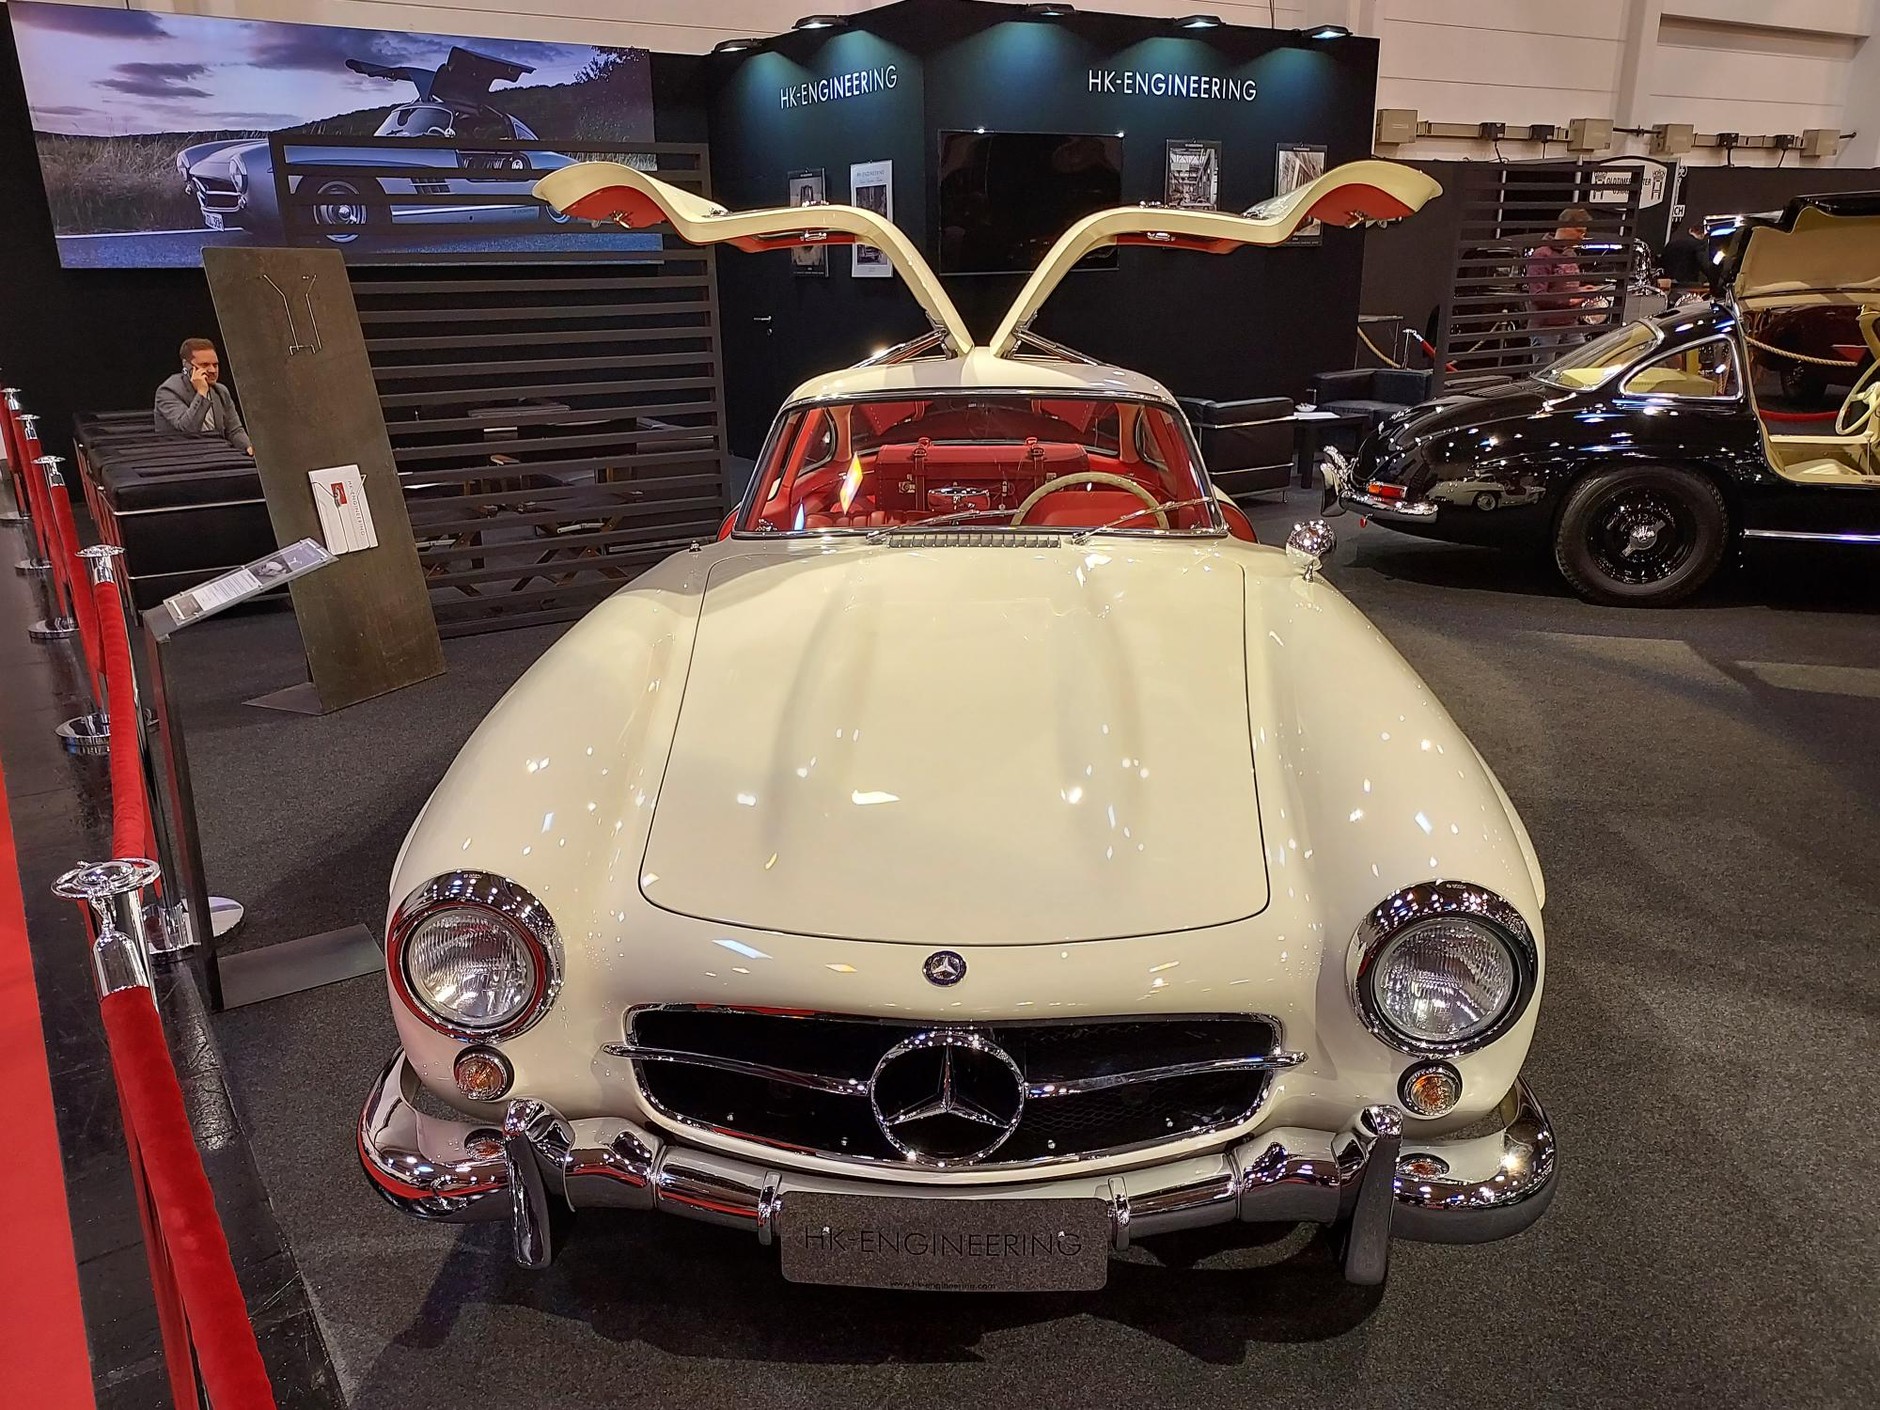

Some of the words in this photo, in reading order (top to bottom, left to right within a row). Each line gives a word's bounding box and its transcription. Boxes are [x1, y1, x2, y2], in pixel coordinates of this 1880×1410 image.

[780, 65, 898, 109] HK-ENGINEERING
[1088, 69, 1257, 101] HK-ENGINEERING
[805, 1226, 1083, 1257] HK-ENGINEERING
